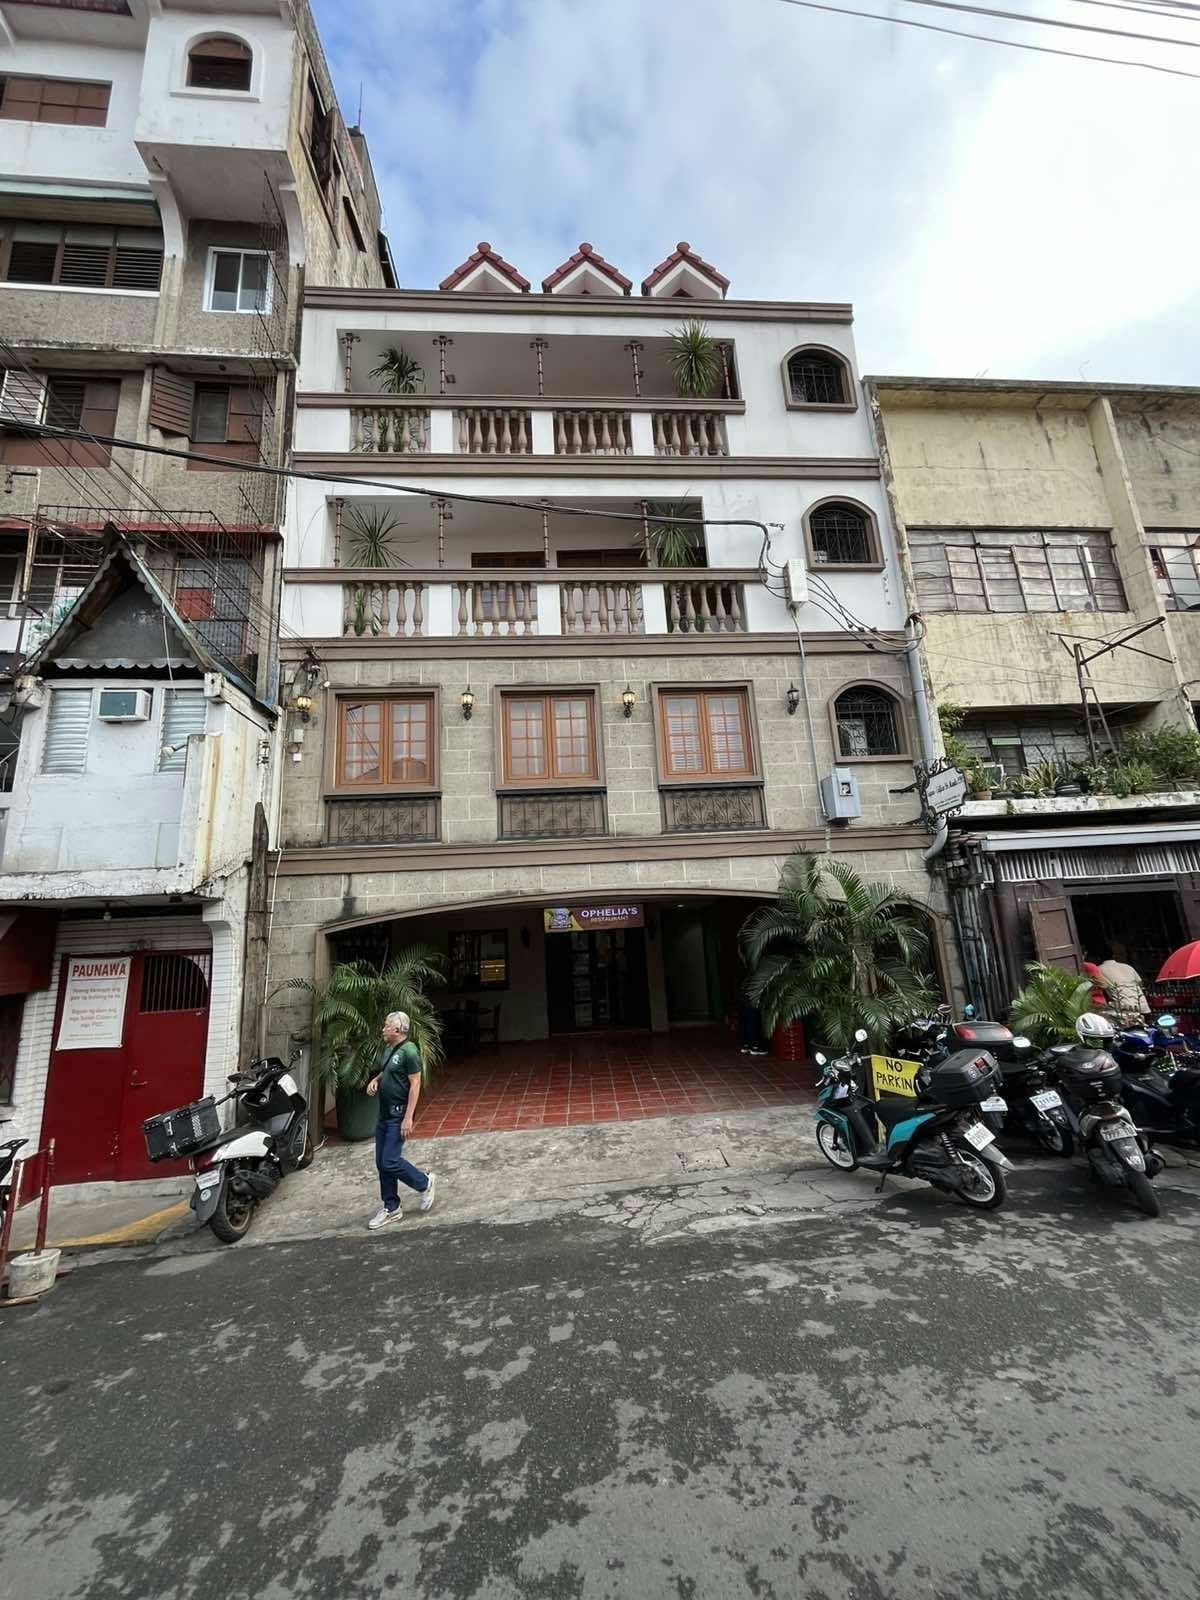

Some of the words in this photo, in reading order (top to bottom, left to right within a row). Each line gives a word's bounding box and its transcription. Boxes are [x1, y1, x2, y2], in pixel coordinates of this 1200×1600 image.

[581, 907, 638, 918] OPHELIA'S
[72, 964, 126, 977] PAUNAWA
[885, 1059, 903, 1073] NO
[876, 1071, 913, 1091] PARKIN
